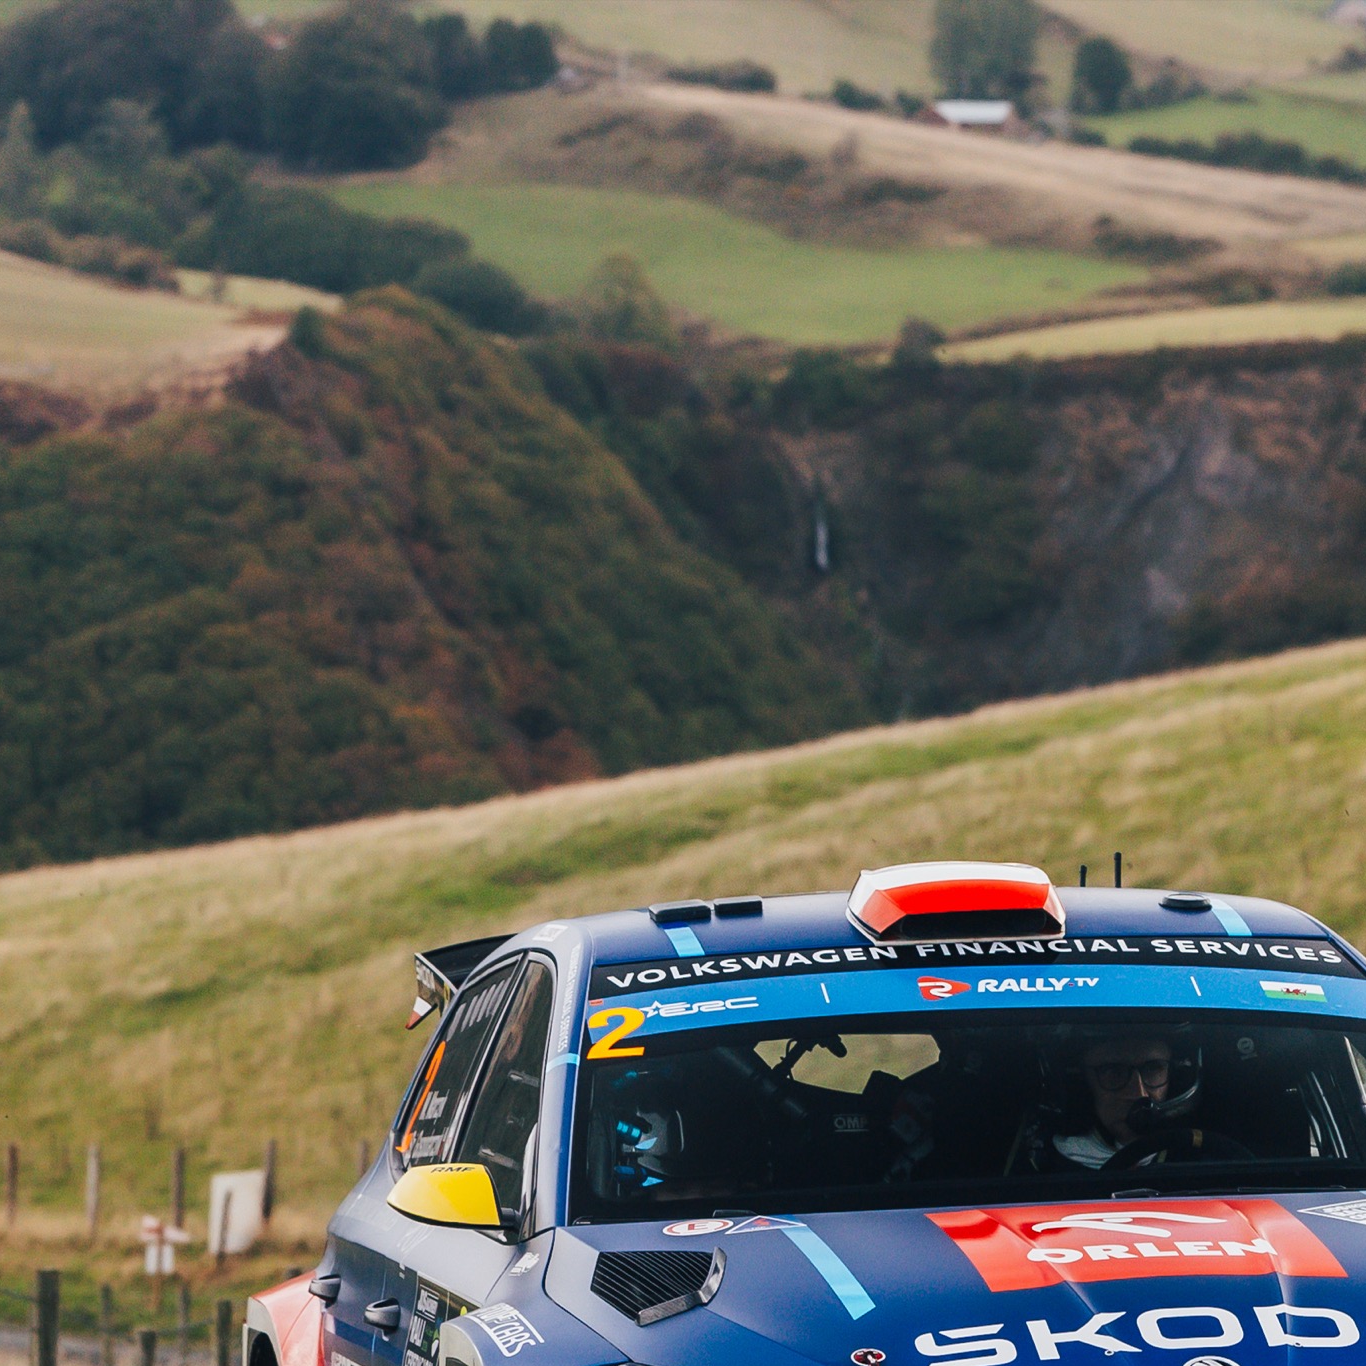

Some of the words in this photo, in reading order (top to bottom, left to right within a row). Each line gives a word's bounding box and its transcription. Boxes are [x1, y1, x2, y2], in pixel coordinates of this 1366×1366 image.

[607, 946, 895, 988] VOLKSWAGEN
[919, 938, 1139, 957] FINANCIAL
[1145, 938, 1343, 963] SERVICES
[586, 1006, 645, 1060] 2
[1026, 1236, 1280, 1265] ORLEN
